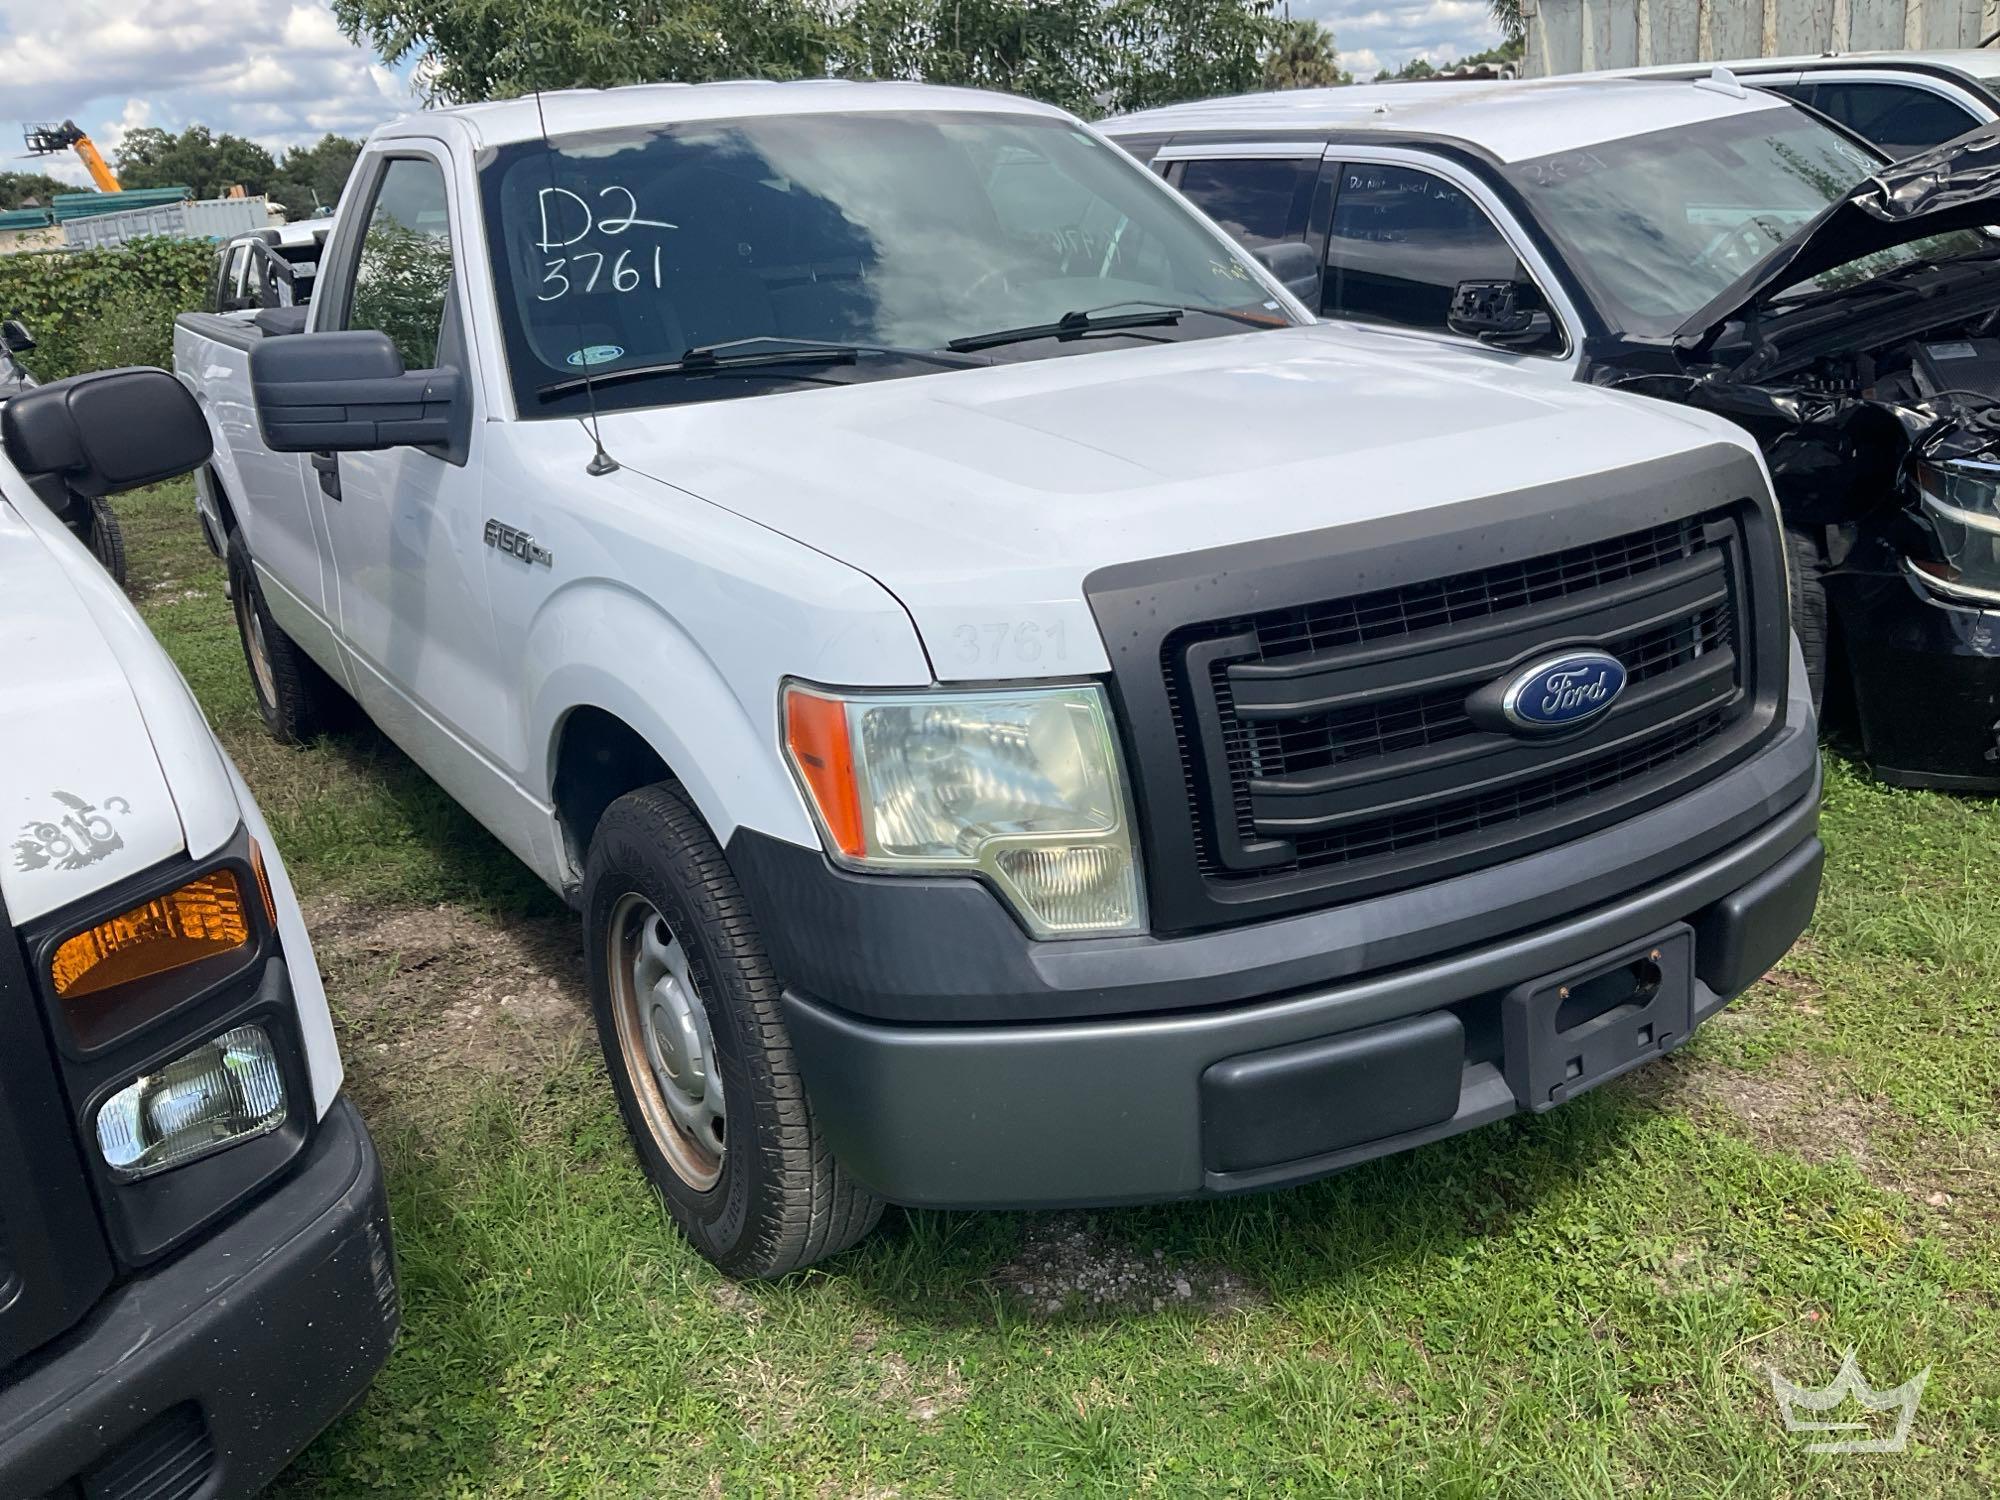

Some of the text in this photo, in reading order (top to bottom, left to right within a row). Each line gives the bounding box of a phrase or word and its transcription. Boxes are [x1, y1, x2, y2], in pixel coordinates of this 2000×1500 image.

[536, 185, 680, 253] D2
[537, 245, 662, 301] 3761
[952, 618, 1067, 665] 3761
[1541, 667, 1607, 715] Ford
